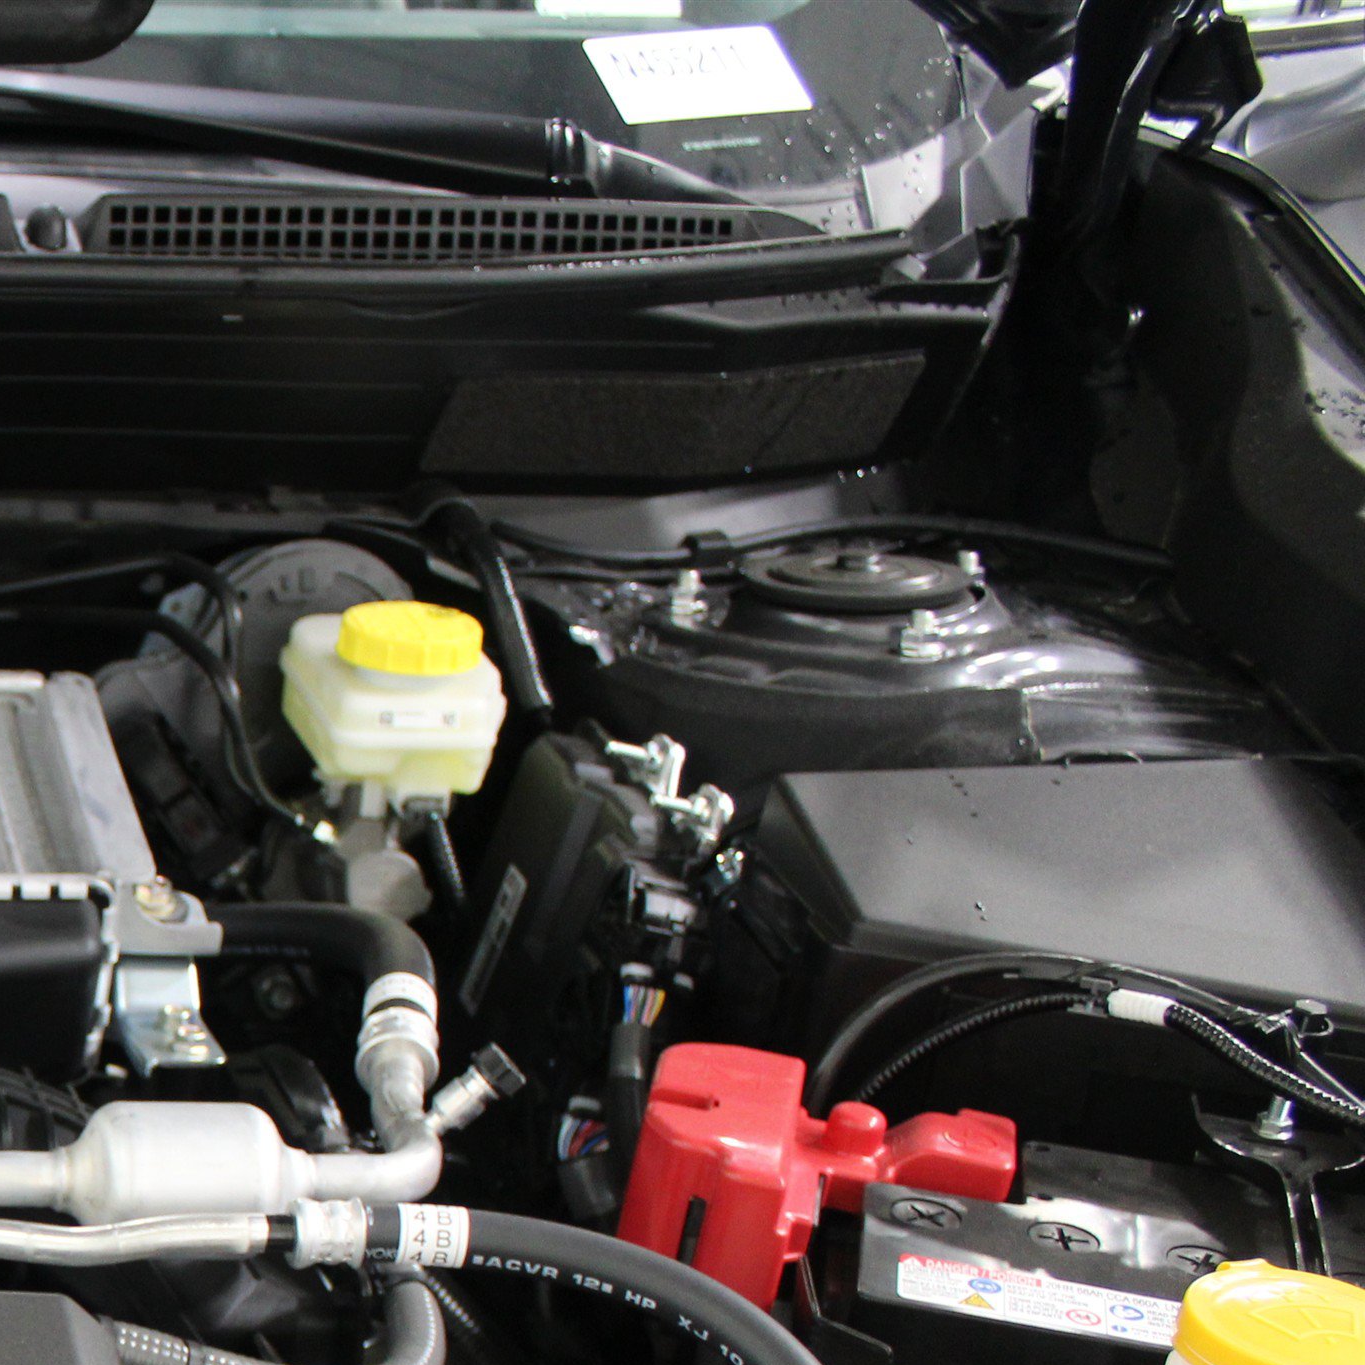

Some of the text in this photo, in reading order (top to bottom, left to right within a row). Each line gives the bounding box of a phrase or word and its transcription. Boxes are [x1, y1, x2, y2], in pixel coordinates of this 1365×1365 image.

[413, 1211, 453, 1226] 4 B
[412, 1229, 452, 1248] 4 B
[924, 1259, 979, 1279] DANGER
[988, 1268, 1037, 1288] POISON
[624, 1289, 658, 1311] HP
